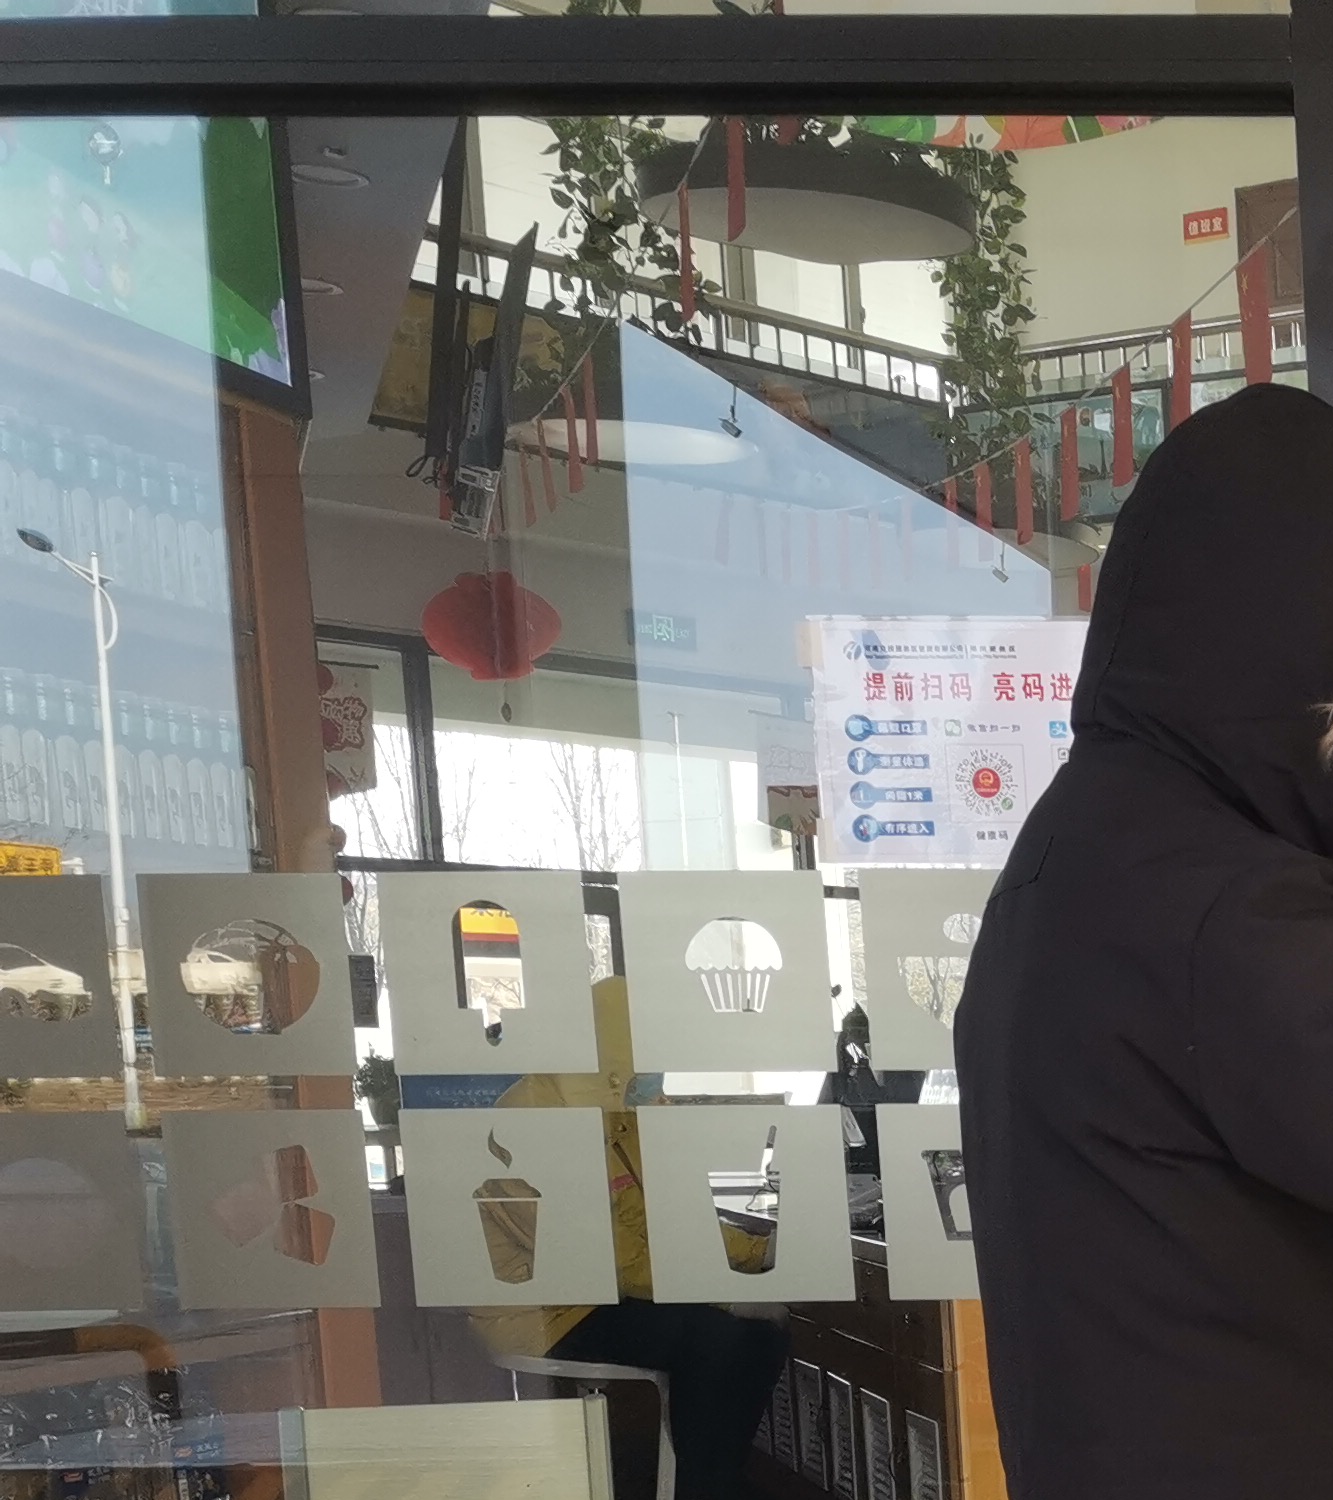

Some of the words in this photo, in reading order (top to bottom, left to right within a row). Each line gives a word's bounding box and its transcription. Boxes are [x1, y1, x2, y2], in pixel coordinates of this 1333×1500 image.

[863, 672, 973, 702] 提前扫码
[993, 672, 1073, 702] 亮码进
